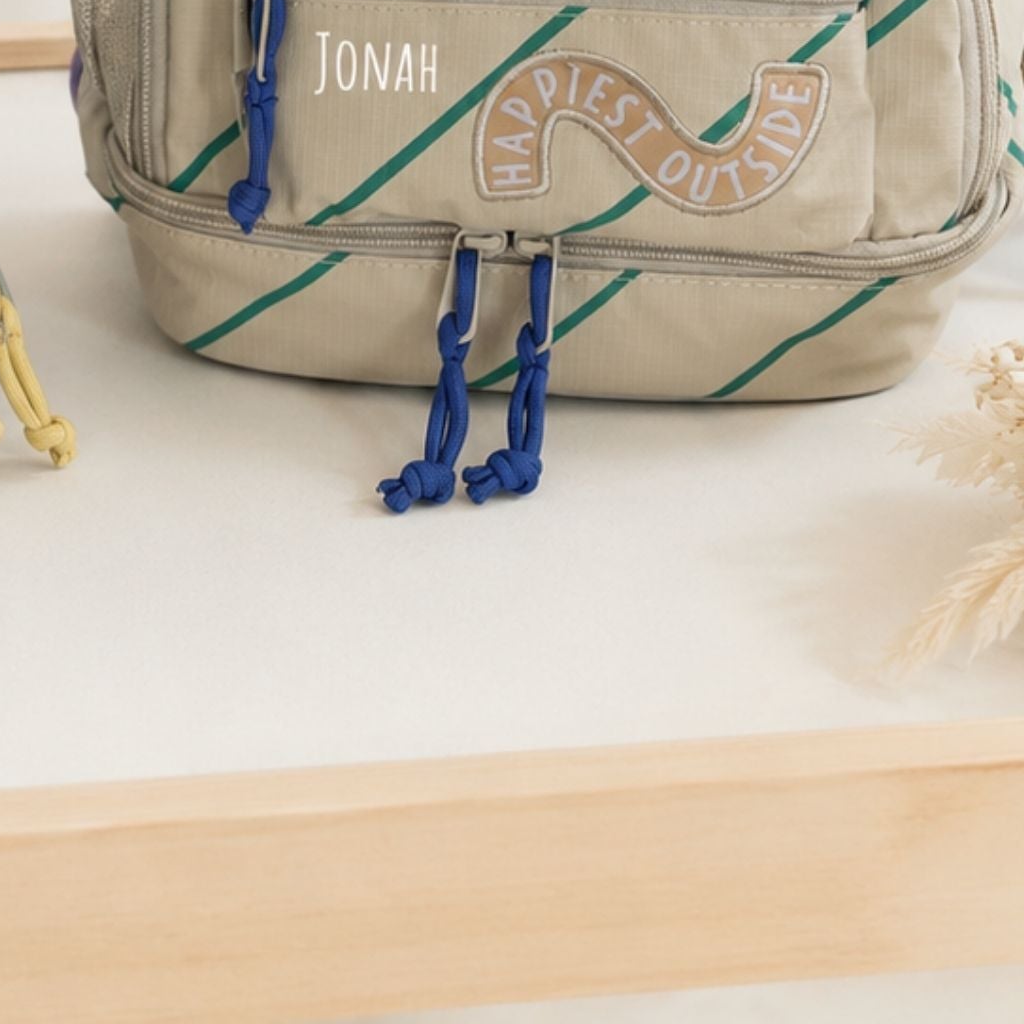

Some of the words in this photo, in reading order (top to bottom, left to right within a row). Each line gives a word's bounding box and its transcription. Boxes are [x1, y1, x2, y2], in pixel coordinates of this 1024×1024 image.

[314, 31, 438, 95] JONAH
[492, 64, 663, 188] HAPPIEST
[657, 83, 811, 202] OUTSIDE
